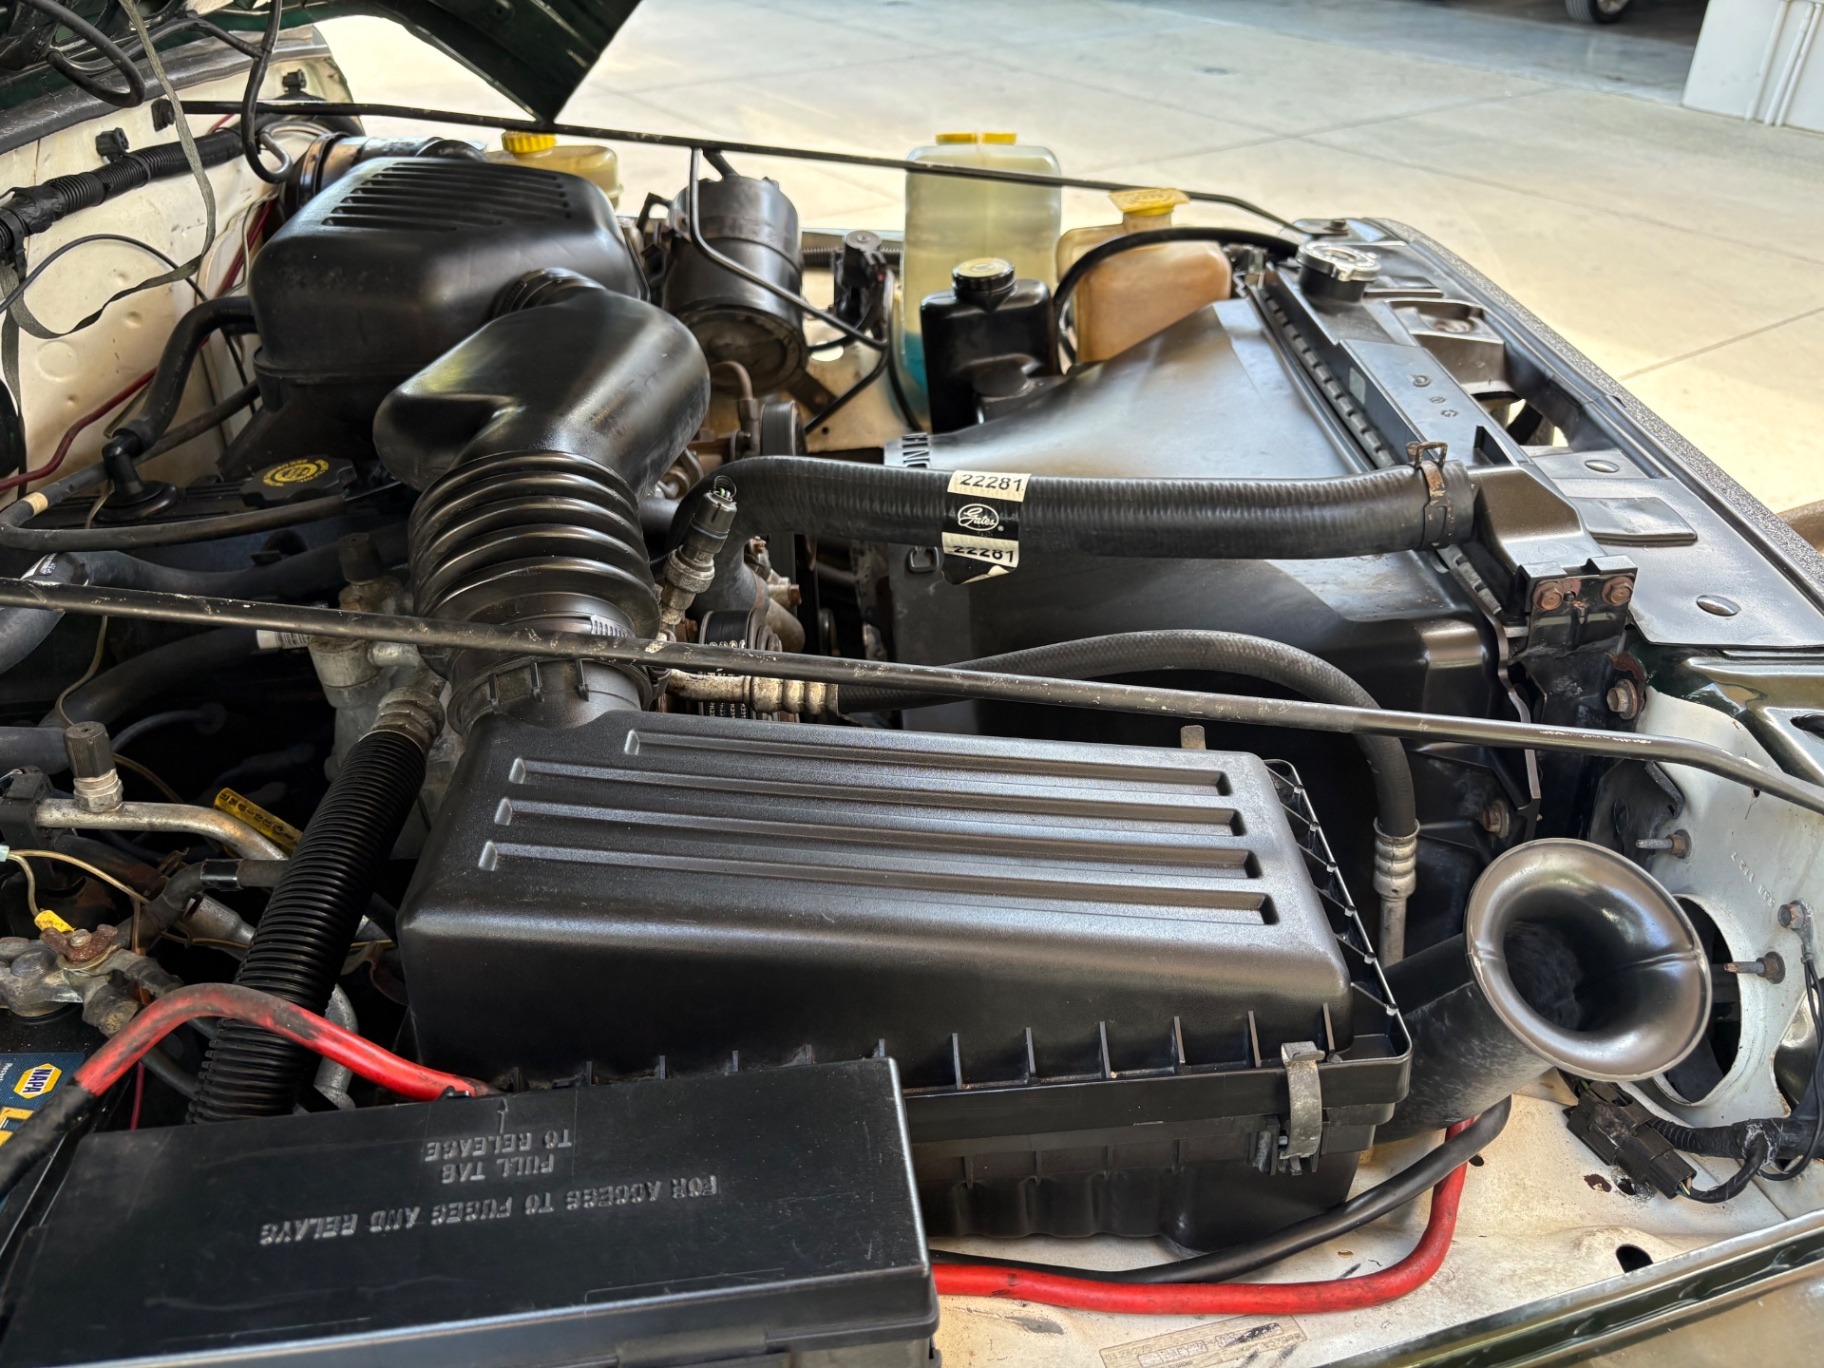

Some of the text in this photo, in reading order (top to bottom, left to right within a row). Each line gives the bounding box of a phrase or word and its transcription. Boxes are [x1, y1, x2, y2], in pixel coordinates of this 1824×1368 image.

[960, 474, 1022, 492] 22281
[959, 507, 997, 529] Gates
[22, 1069, 53, 1094] NAPA
[424, 1128, 573, 1162] TO RELEASE
[441, 1153, 555, 1184] PULL TAB
[259, 1174, 718, 1245] FOR ACCESS TO FUSES AND RELAYS
